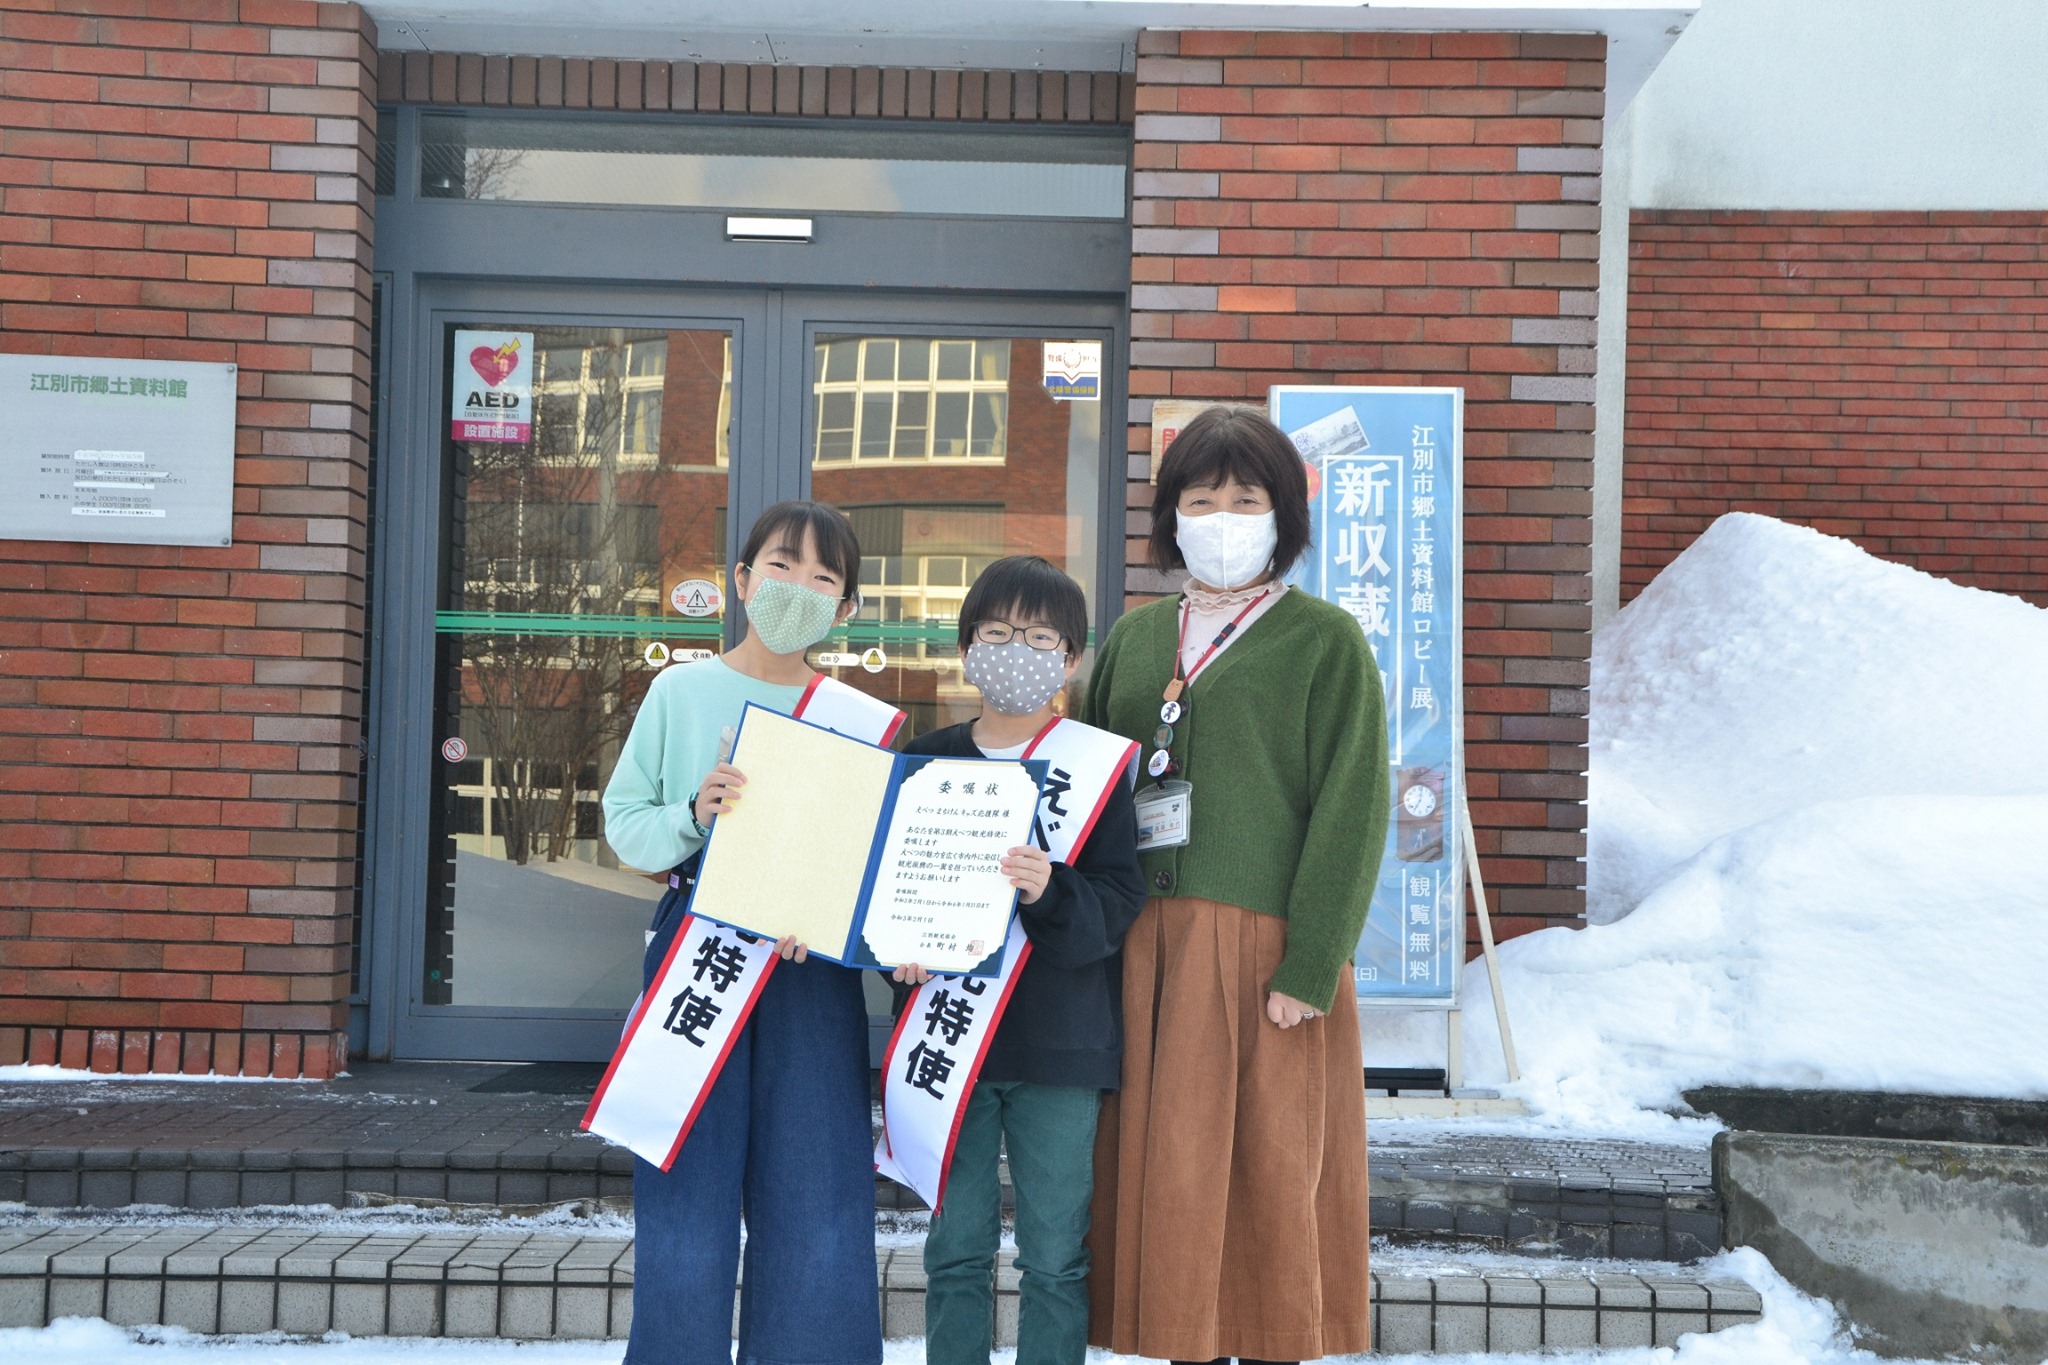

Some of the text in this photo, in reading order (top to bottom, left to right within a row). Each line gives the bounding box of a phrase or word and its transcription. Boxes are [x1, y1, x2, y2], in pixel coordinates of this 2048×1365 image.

[30, 373, 188, 398] 江別市郷土資料館
[466, 391, 519, 408] AED
[464, 424, 519, 439] 設置施設
[1334, 462, 1391, 695] 新収蔵
[1410, 425, 1435, 709] 江別市郷土資料館ロビー展
[939, 780, 999, 796] 委嘱状
[1409, 876, 1431, 981] 観覧無料
[663, 924, 758, 1048] 特使
